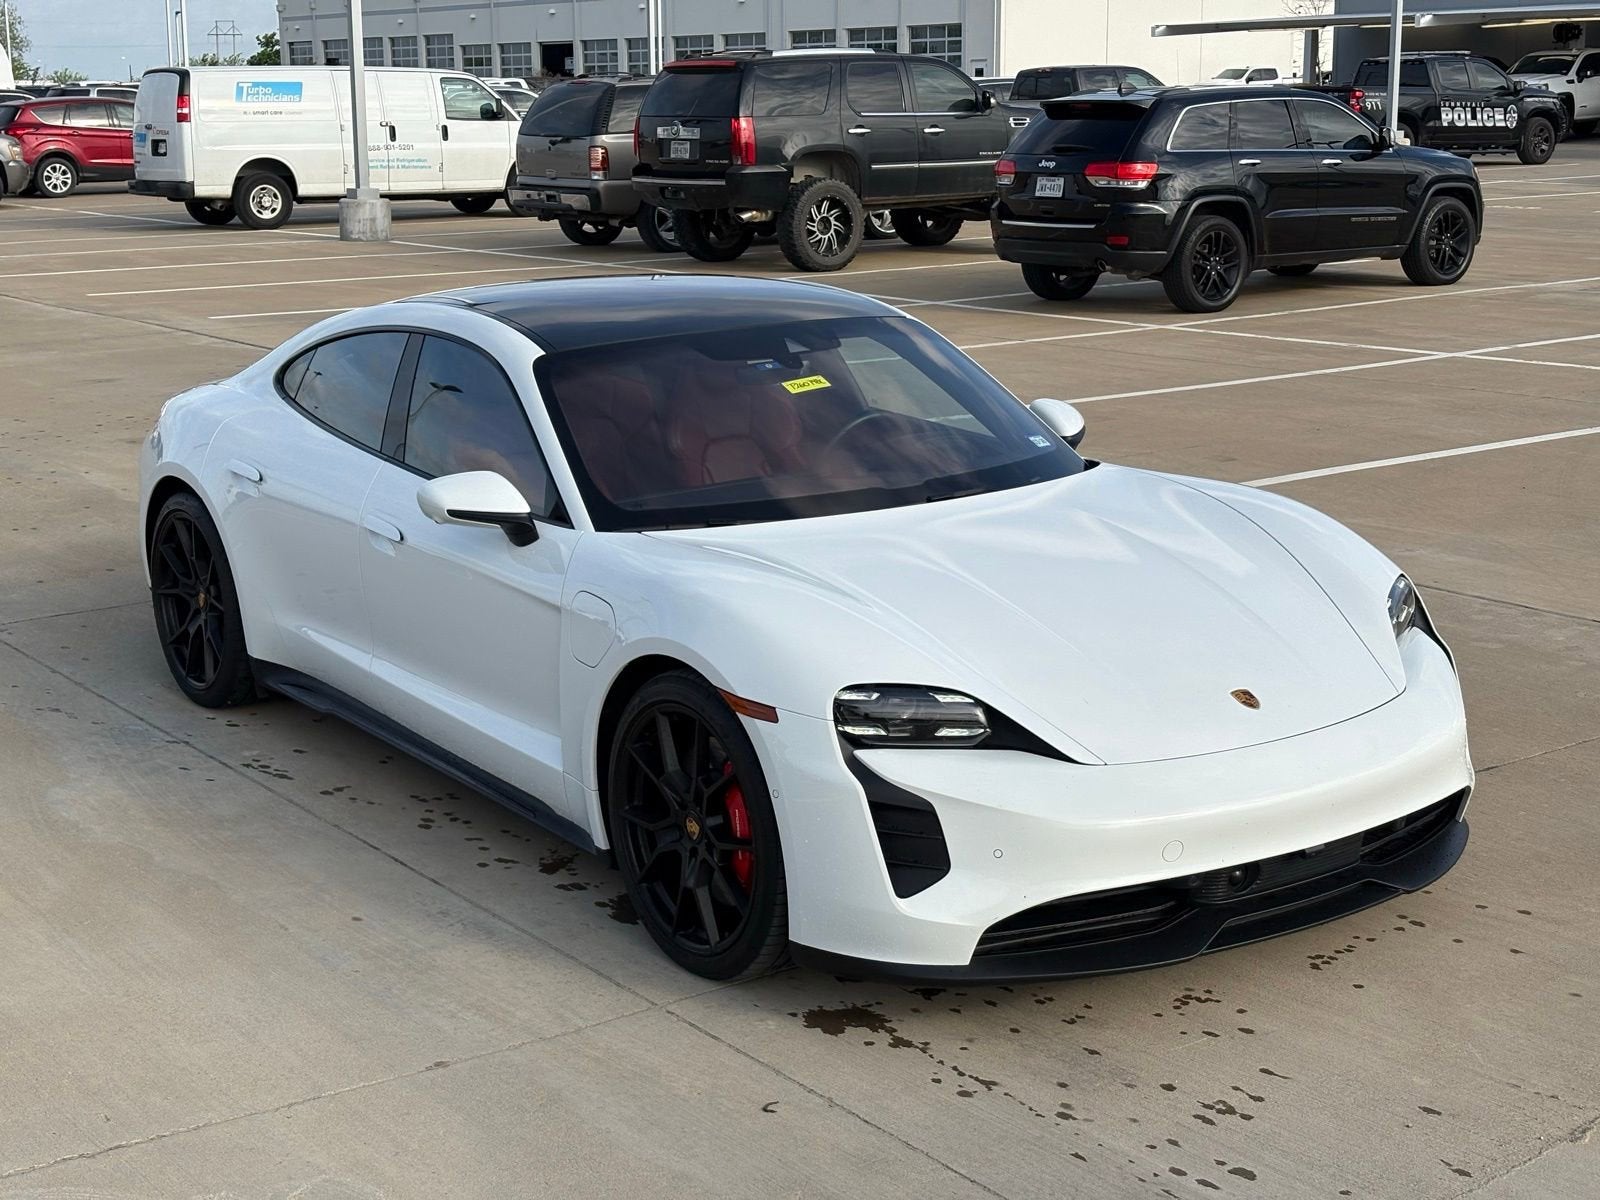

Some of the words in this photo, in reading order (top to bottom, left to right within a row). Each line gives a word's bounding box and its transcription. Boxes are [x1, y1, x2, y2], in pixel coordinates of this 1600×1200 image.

[239, 82, 272, 100] Turbo
[1365, 101, 1382, 111] 911
[1440, 107, 1507, 127] POLICE
[1038, 160, 1056, 168] Jeep
